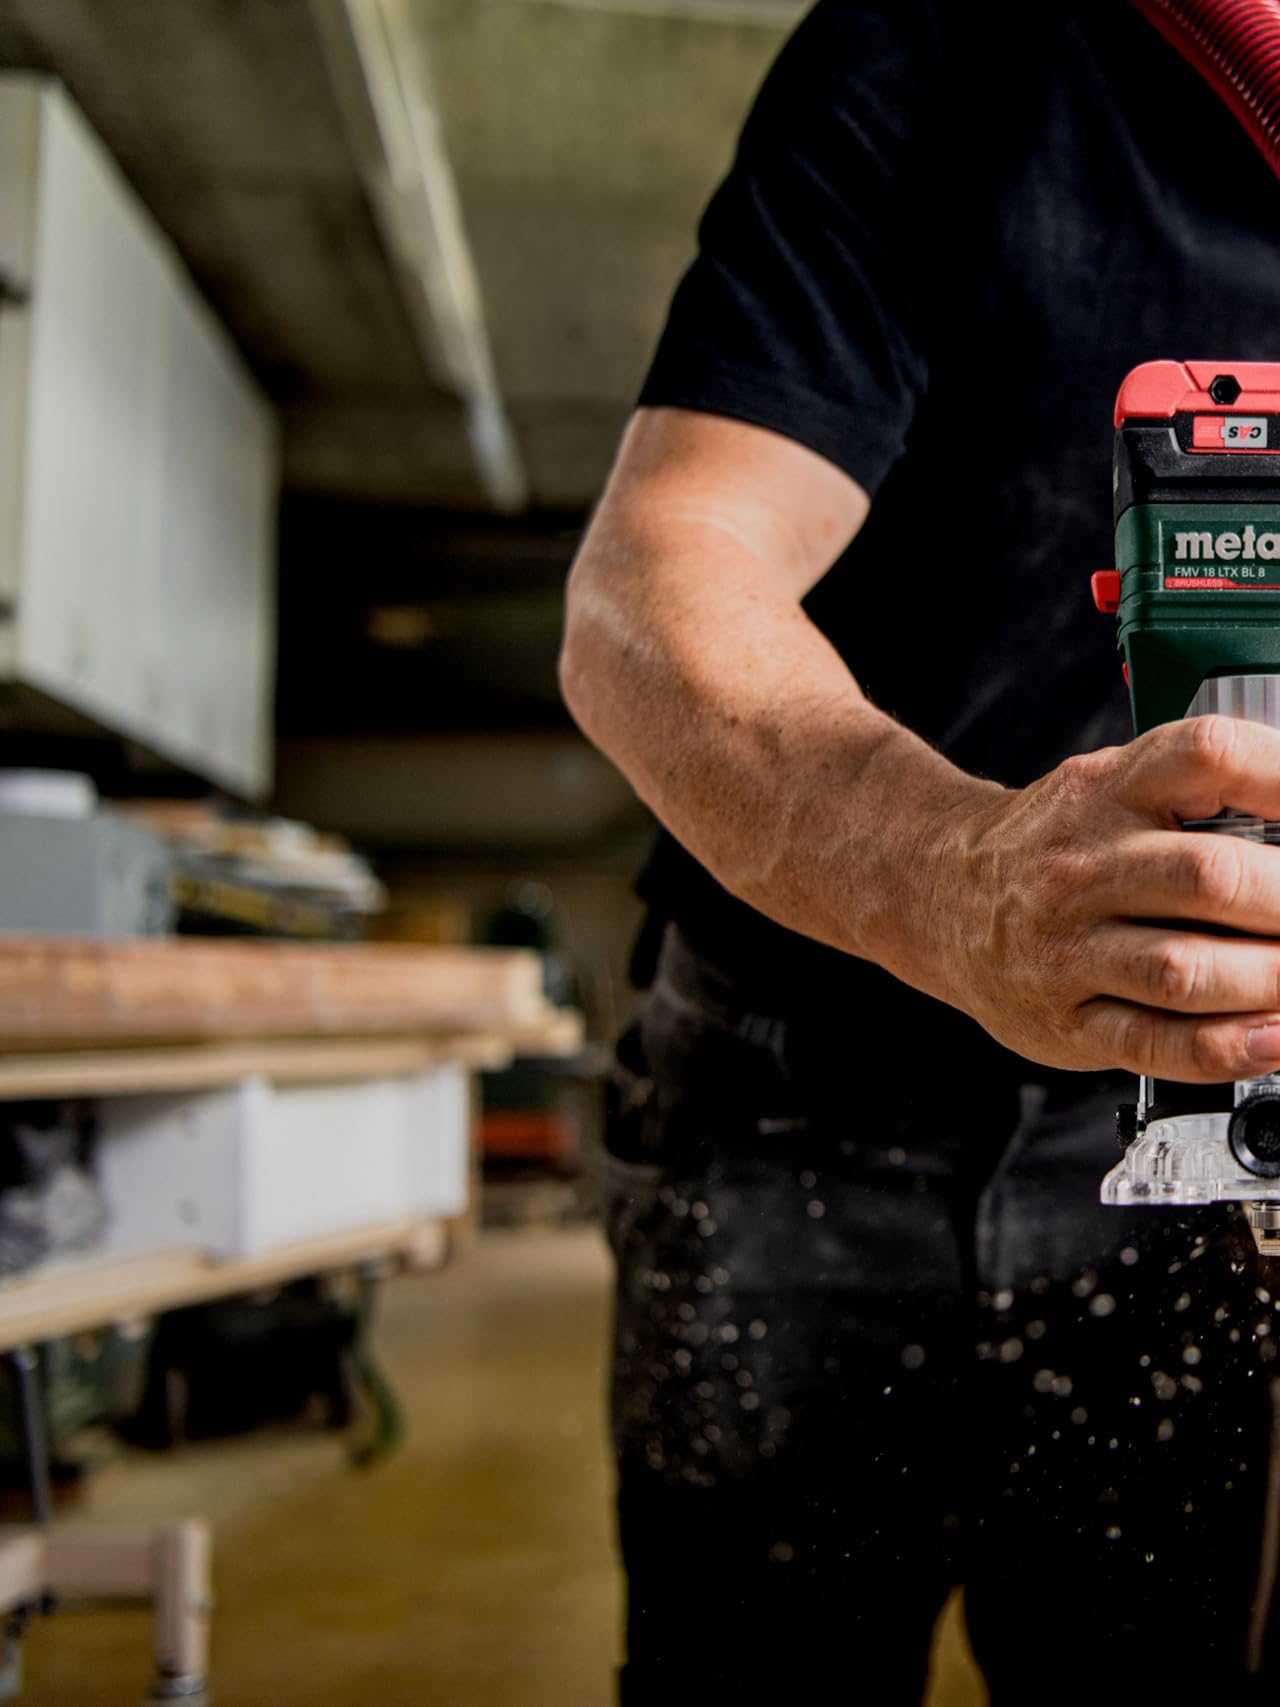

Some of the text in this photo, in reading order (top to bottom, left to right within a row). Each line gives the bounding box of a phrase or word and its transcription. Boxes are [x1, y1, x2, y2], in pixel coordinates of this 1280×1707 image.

[1174, 567, 1266, 578] FMV 18 LTX BL 8
[1174, 579, 1223, 588] BRUSHLESS
